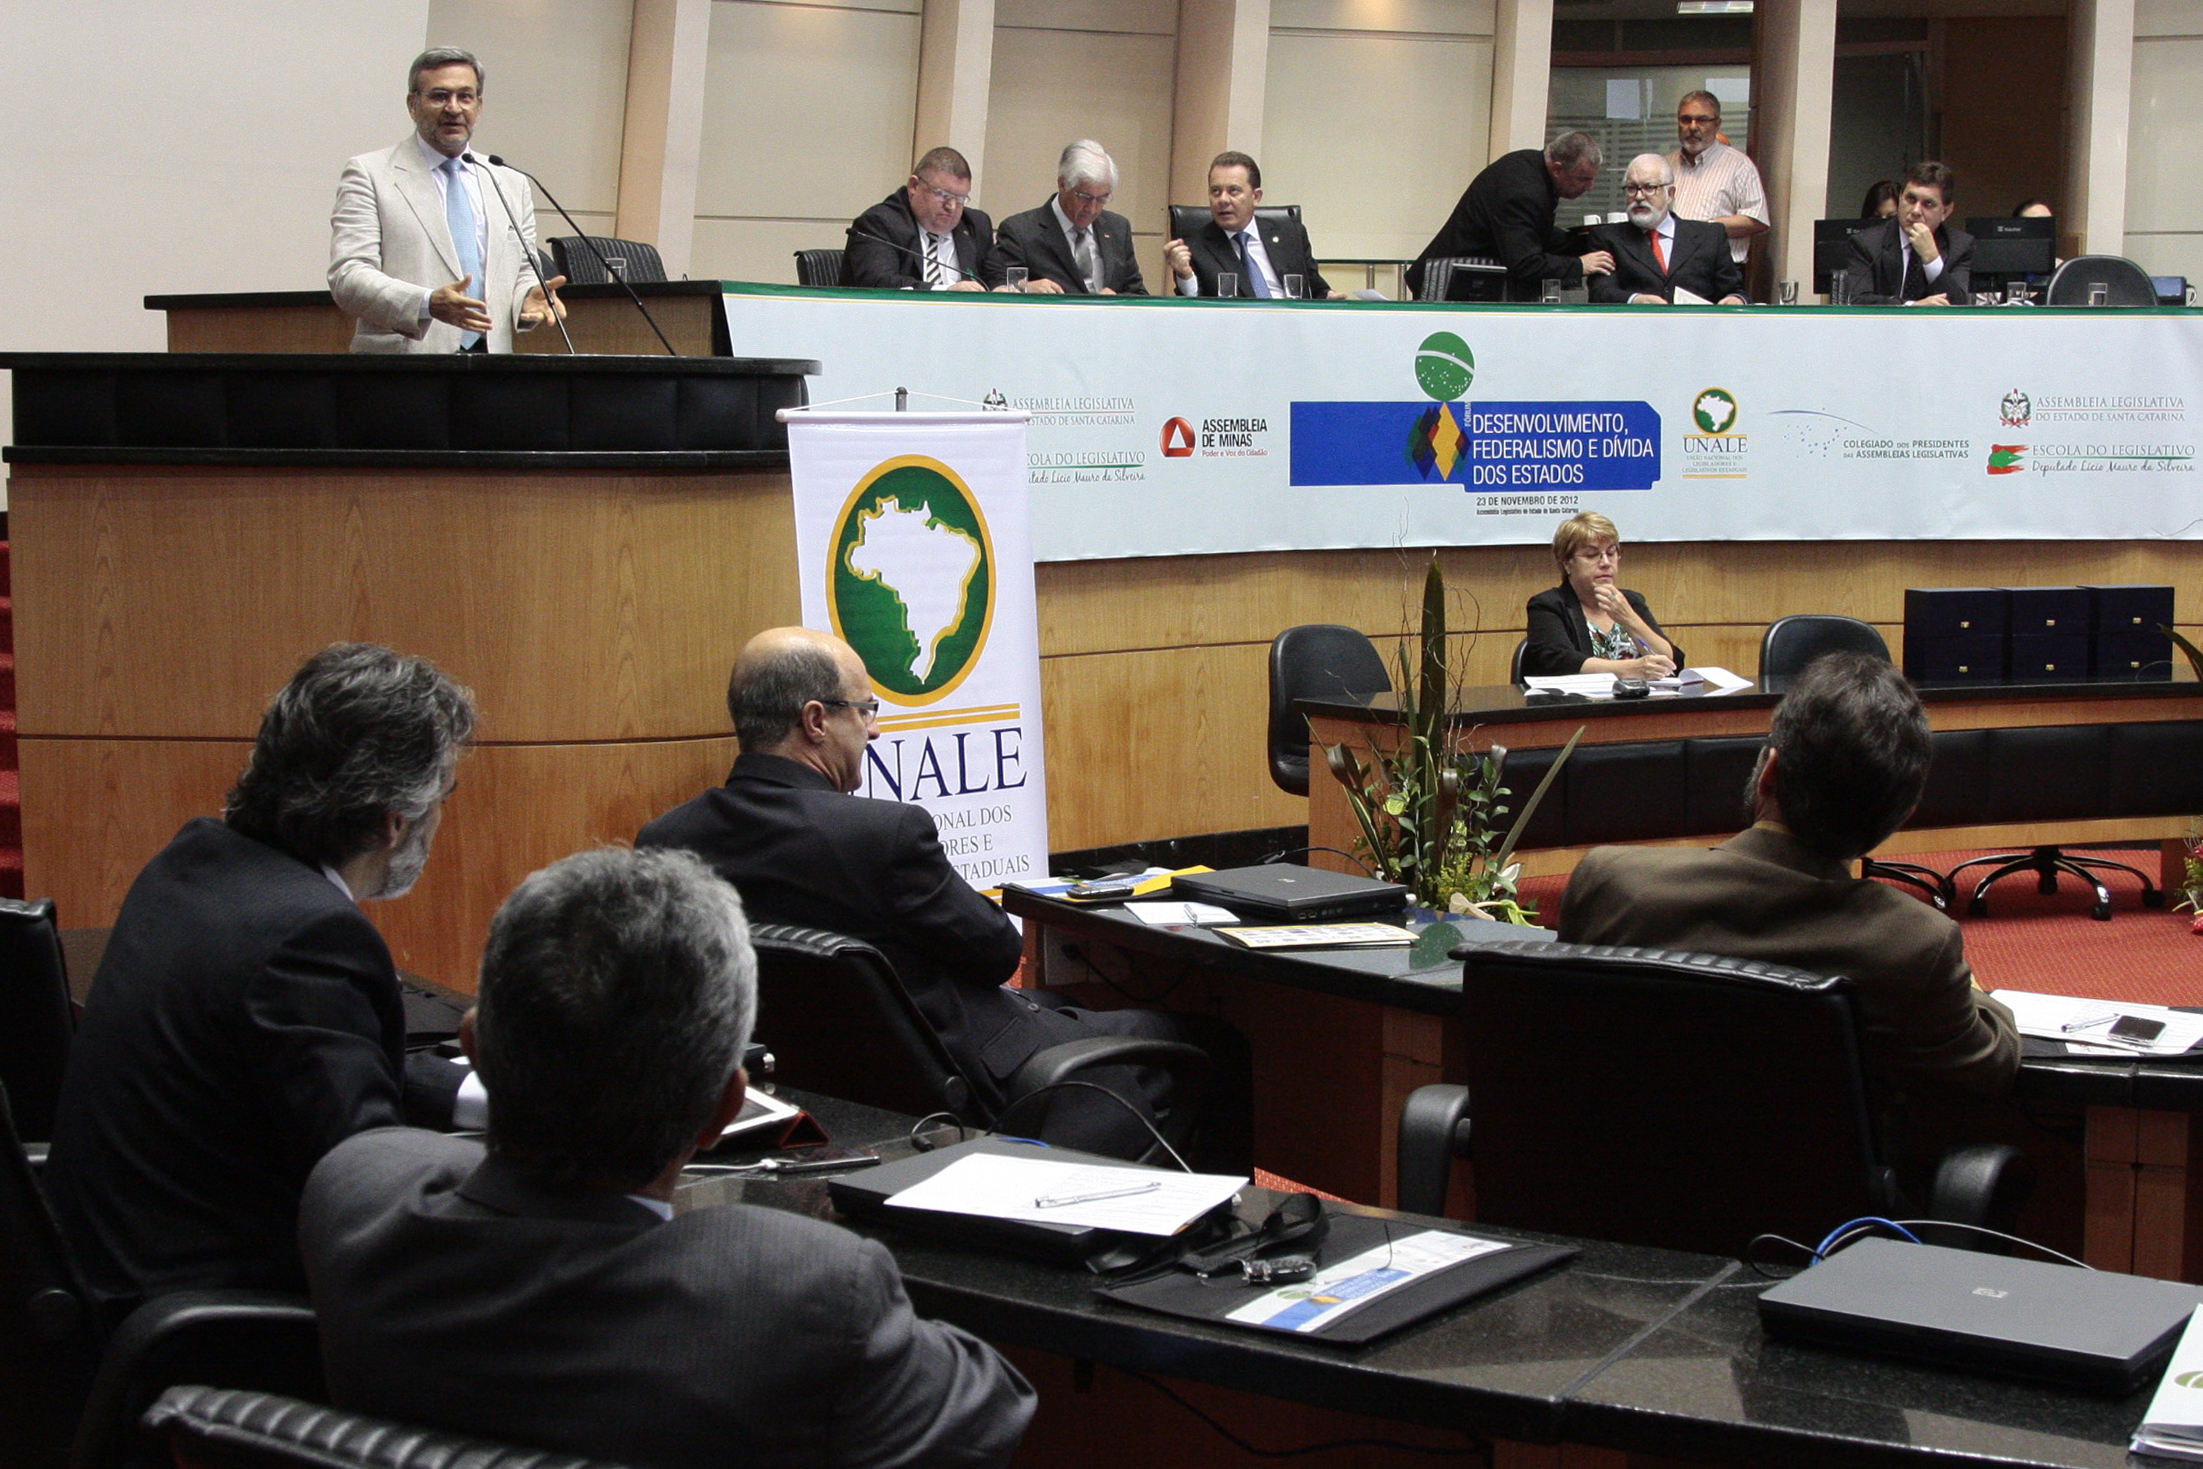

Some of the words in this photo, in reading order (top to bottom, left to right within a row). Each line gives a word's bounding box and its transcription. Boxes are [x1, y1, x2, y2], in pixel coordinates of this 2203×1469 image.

[1012, 397, 1071, 410] ASSEMBLEIA
[1074, 397, 1134, 410] LEGISLATIVA
[2036, 397, 2107, 408] ASSEMBLEIA
[2111, 397, 2184, 408] LEGISLATIVA
[1027, 416, 1056, 426] ESTADO
[1058, 416, 1069, 426] DE
[1070, 416, 1095, 425] SANTA
[1096, 415, 1135, 424] CATARINA
[1472, 413, 1629, 435] DESENVOLVIMENTO,
[2036, 412, 2050, 422] DO
[2053, 412, 2089, 422] ESTADO
[2092, 412, 2103, 422] DE
[2107, 412, 2135, 422] SANTA
[2137, 412, 2185, 422] CATARINA
[1202, 418, 1268, 432] ASSEMBLEIA
[1202, 434, 1215, 447] DE
[1219, 433, 1253, 447] MINAS
[1472, 438, 1584, 459] FEDERALISMO
[1589, 439, 1598, 458] E
[1602, 434, 1654, 458] DÍVIDA
[1682, 438, 1748, 453] UNALE
[1843, 440, 1894, 448] COLEGIADO
[1912, 440, 1970, 448] PRESIDENTES
[1856, 450, 1910, 458] ASSEMBLEIAS
[1912, 450, 1969, 458] LEGISLATIVAS
[2032, 444, 2081, 456] ESCOLA
[2086, 444, 2107, 456] DO
[2112, 444, 2196, 456] LEGISLATIVO
[1026, 452, 1052, 466] OLA
[1055, 452, 1073, 465] DO
[1076, 451, 1146, 464] LEGISLATIVO
[1472, 464, 1508, 485] DOS
[1512, 464, 1584, 484] ESTADOS
[2032, 460, 2078, 477] Deputado
[2080, 460, 2103, 472] Lício
[2106, 460, 2137, 472] Mauro
[2140, 460, 2154, 472] da
[2156, 458, 2196, 472] Silveira
[1073, 470, 1100, 484] Mauro
[1102, 468, 1112, 482] da
[1114, 467, 1146, 482] Silveira
[1476, 496, 1486, 506] 23
[1488, 496, 1498, 506] DE
[1500, 496, 1546, 506] NOVEMBRO
[1548, 496, 1558, 504] DE
[1560, 495, 1578, 504] 2012
[866, 727, 1028, 802] NALE
[932, 810, 976, 832] ONAL
[980, 804, 1012, 826] DOS
[983, 834, 994, 852] E
[952, 854, 1030, 880] TADUAIS
